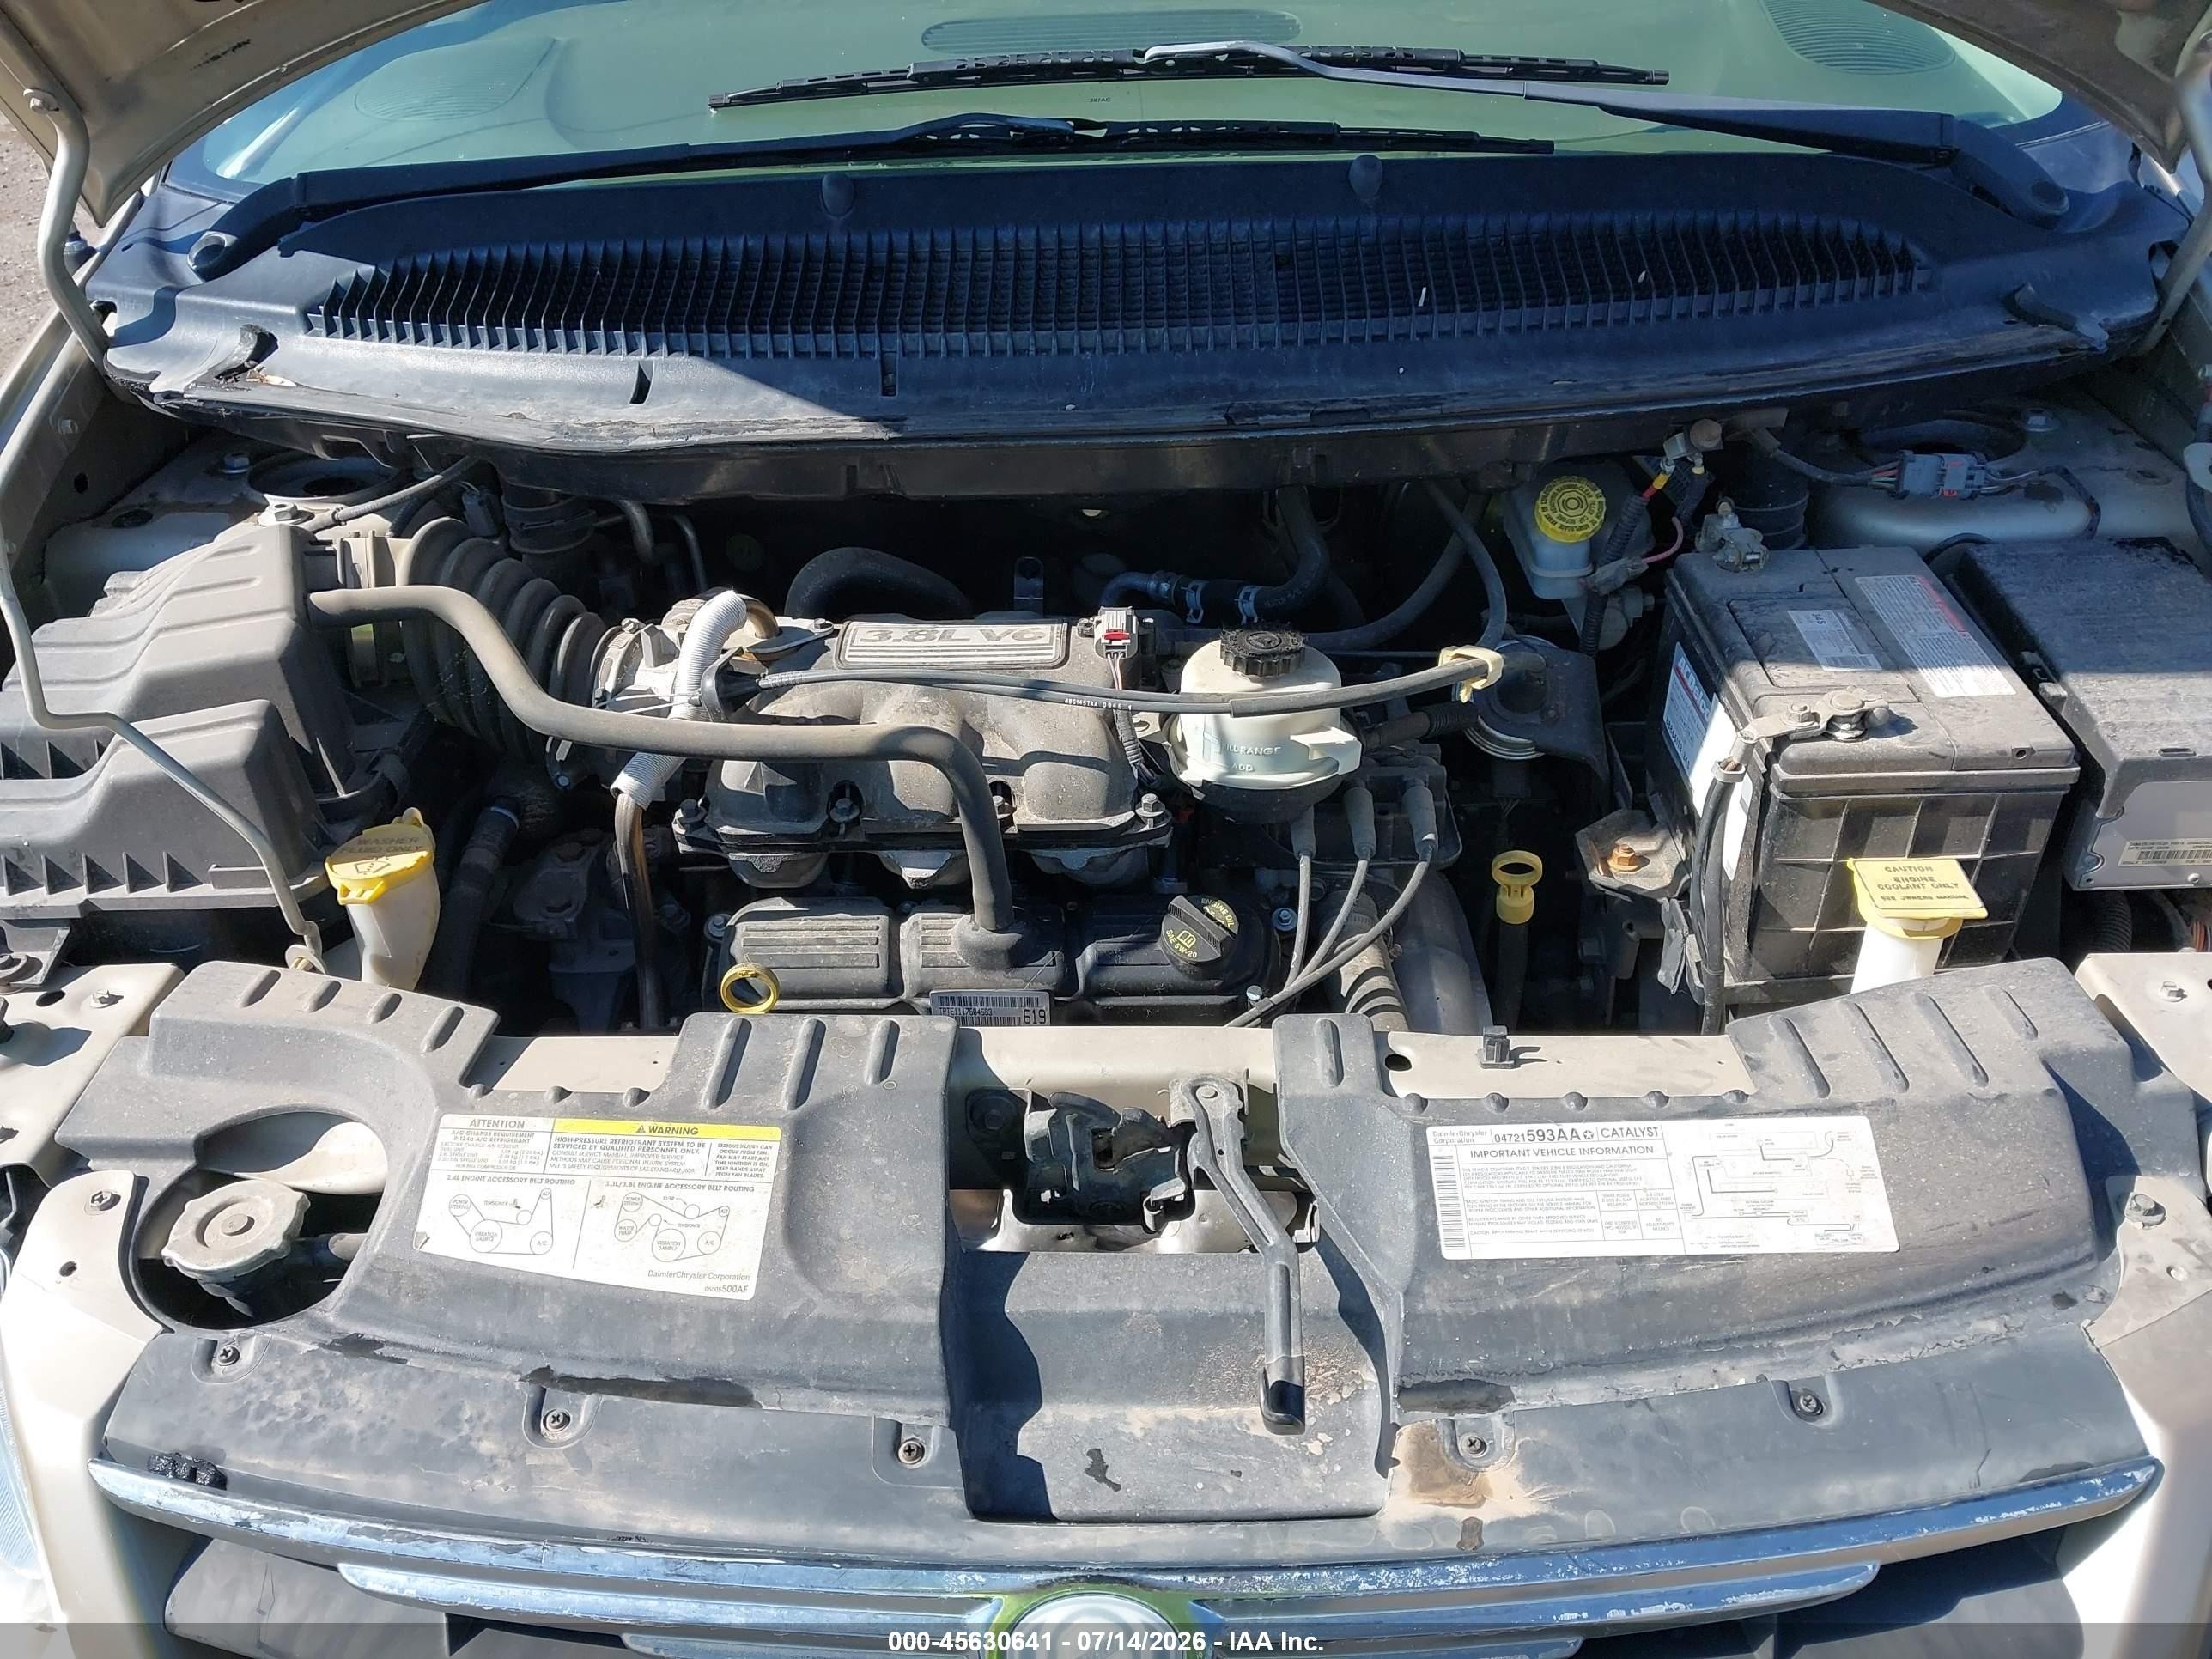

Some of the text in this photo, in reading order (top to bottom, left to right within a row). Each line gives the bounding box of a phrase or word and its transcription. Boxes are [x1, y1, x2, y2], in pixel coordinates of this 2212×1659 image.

[860, 628, 1046, 643] 3.8L V6
[1231, 763, 1255, 773] ADD
[357, 836, 419, 846] WASHER
[1201, 898, 1235, 928] ENGINE OIL
[1166, 929, 1198, 958] SAE 5W-20
[1023, 1008, 1047, 1024] 619
[470, 1119, 526, 1129] ATTENTION
[648, 1126, 699, 1136] WARNING
[1432, 1129, 1488, 1139] DaimlerChrysler
[1494, 1127, 1581, 1145] 04721593AA
[1600, 1127, 1660, 1139] CATALYST
[555, 1136, 607, 1145] HIGH-PRESSURE
[610, 1138, 657, 1147] REFRIGERANT
[1433, 1137, 1475, 1146] Corporation
[599, 1144, 636, 1152] QUALIFIED
[1470, 1146, 1655, 1160] IMPORTANT VEHICLE INFORMATION
[487, 1176, 528, 1184] ACCESSORY
[664, 1182, 707, 1191] ACCESSORY
[647, 1269, 751, 1283] DaimlerChrysler Corporation
